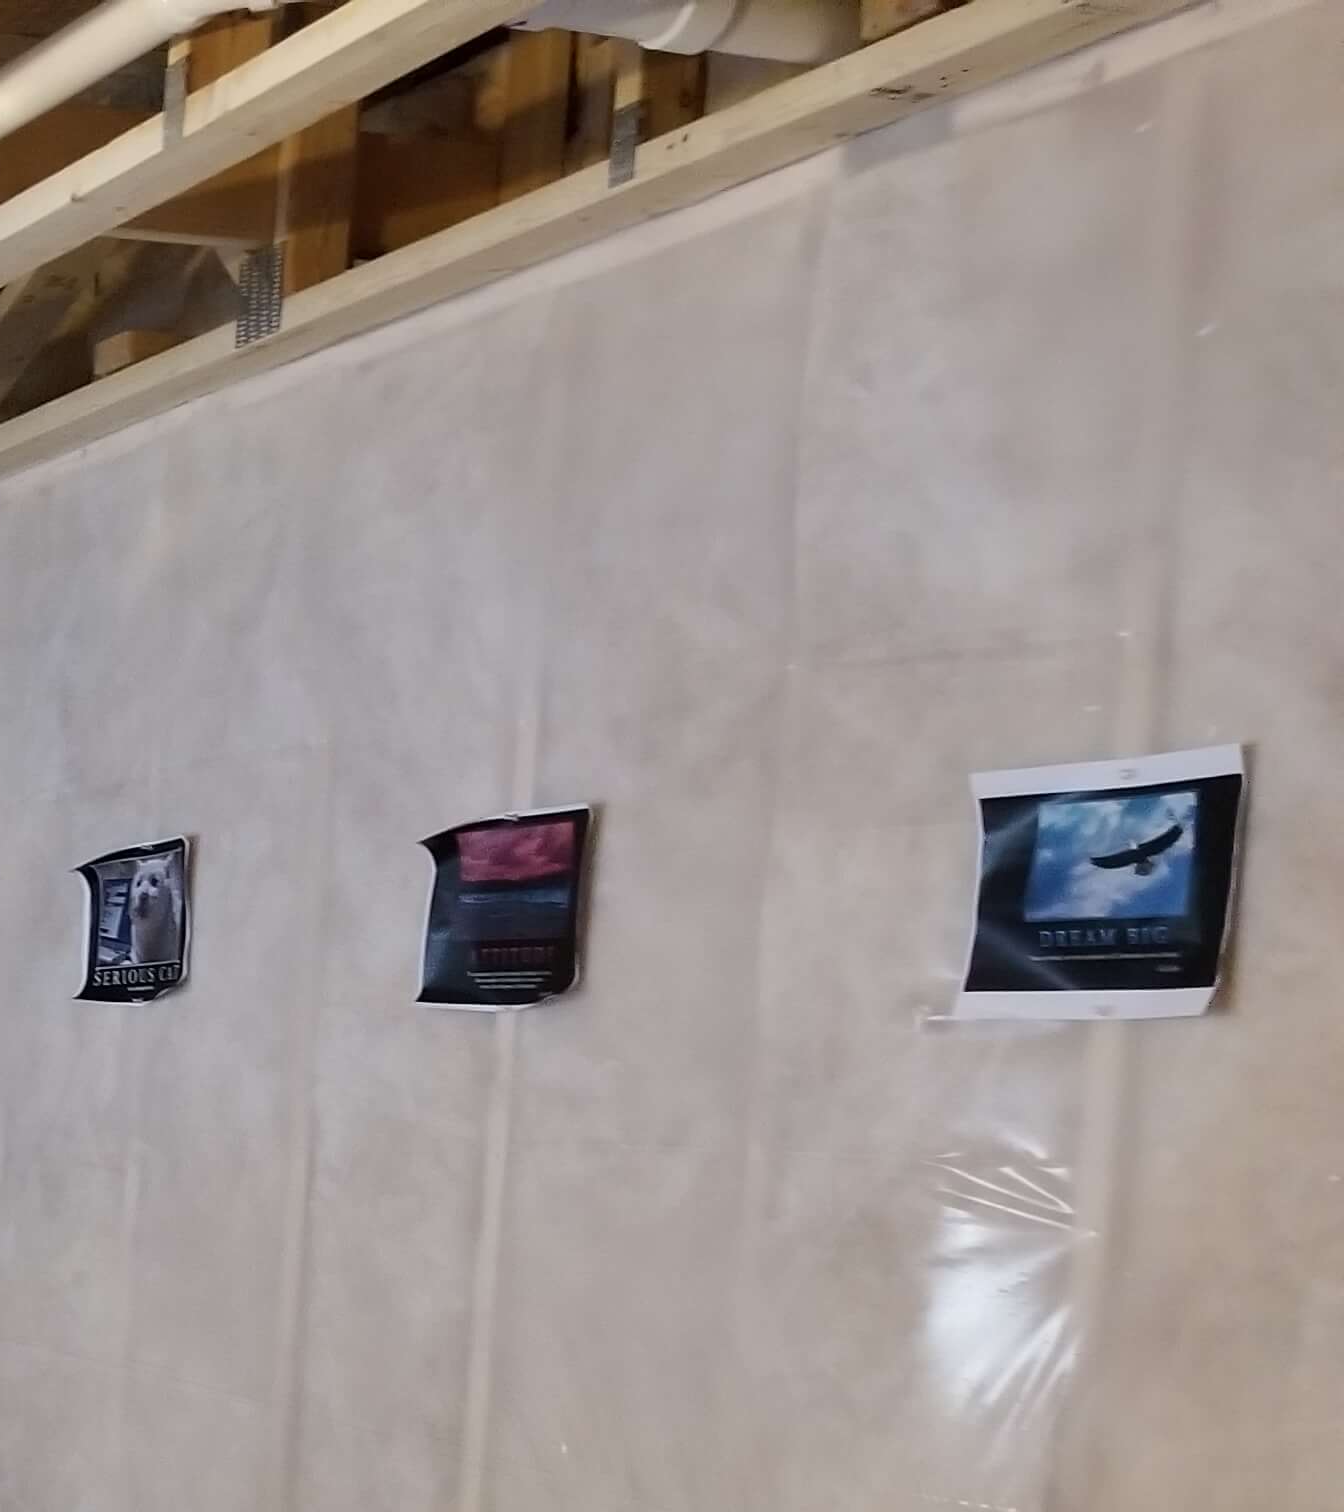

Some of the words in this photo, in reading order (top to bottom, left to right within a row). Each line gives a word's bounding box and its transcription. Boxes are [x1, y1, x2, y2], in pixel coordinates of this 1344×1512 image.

[1039, 928, 1118, 948] DREAM
[1127, 926, 1169, 945] BIG
[92, 967, 155, 987] SERIOUS
